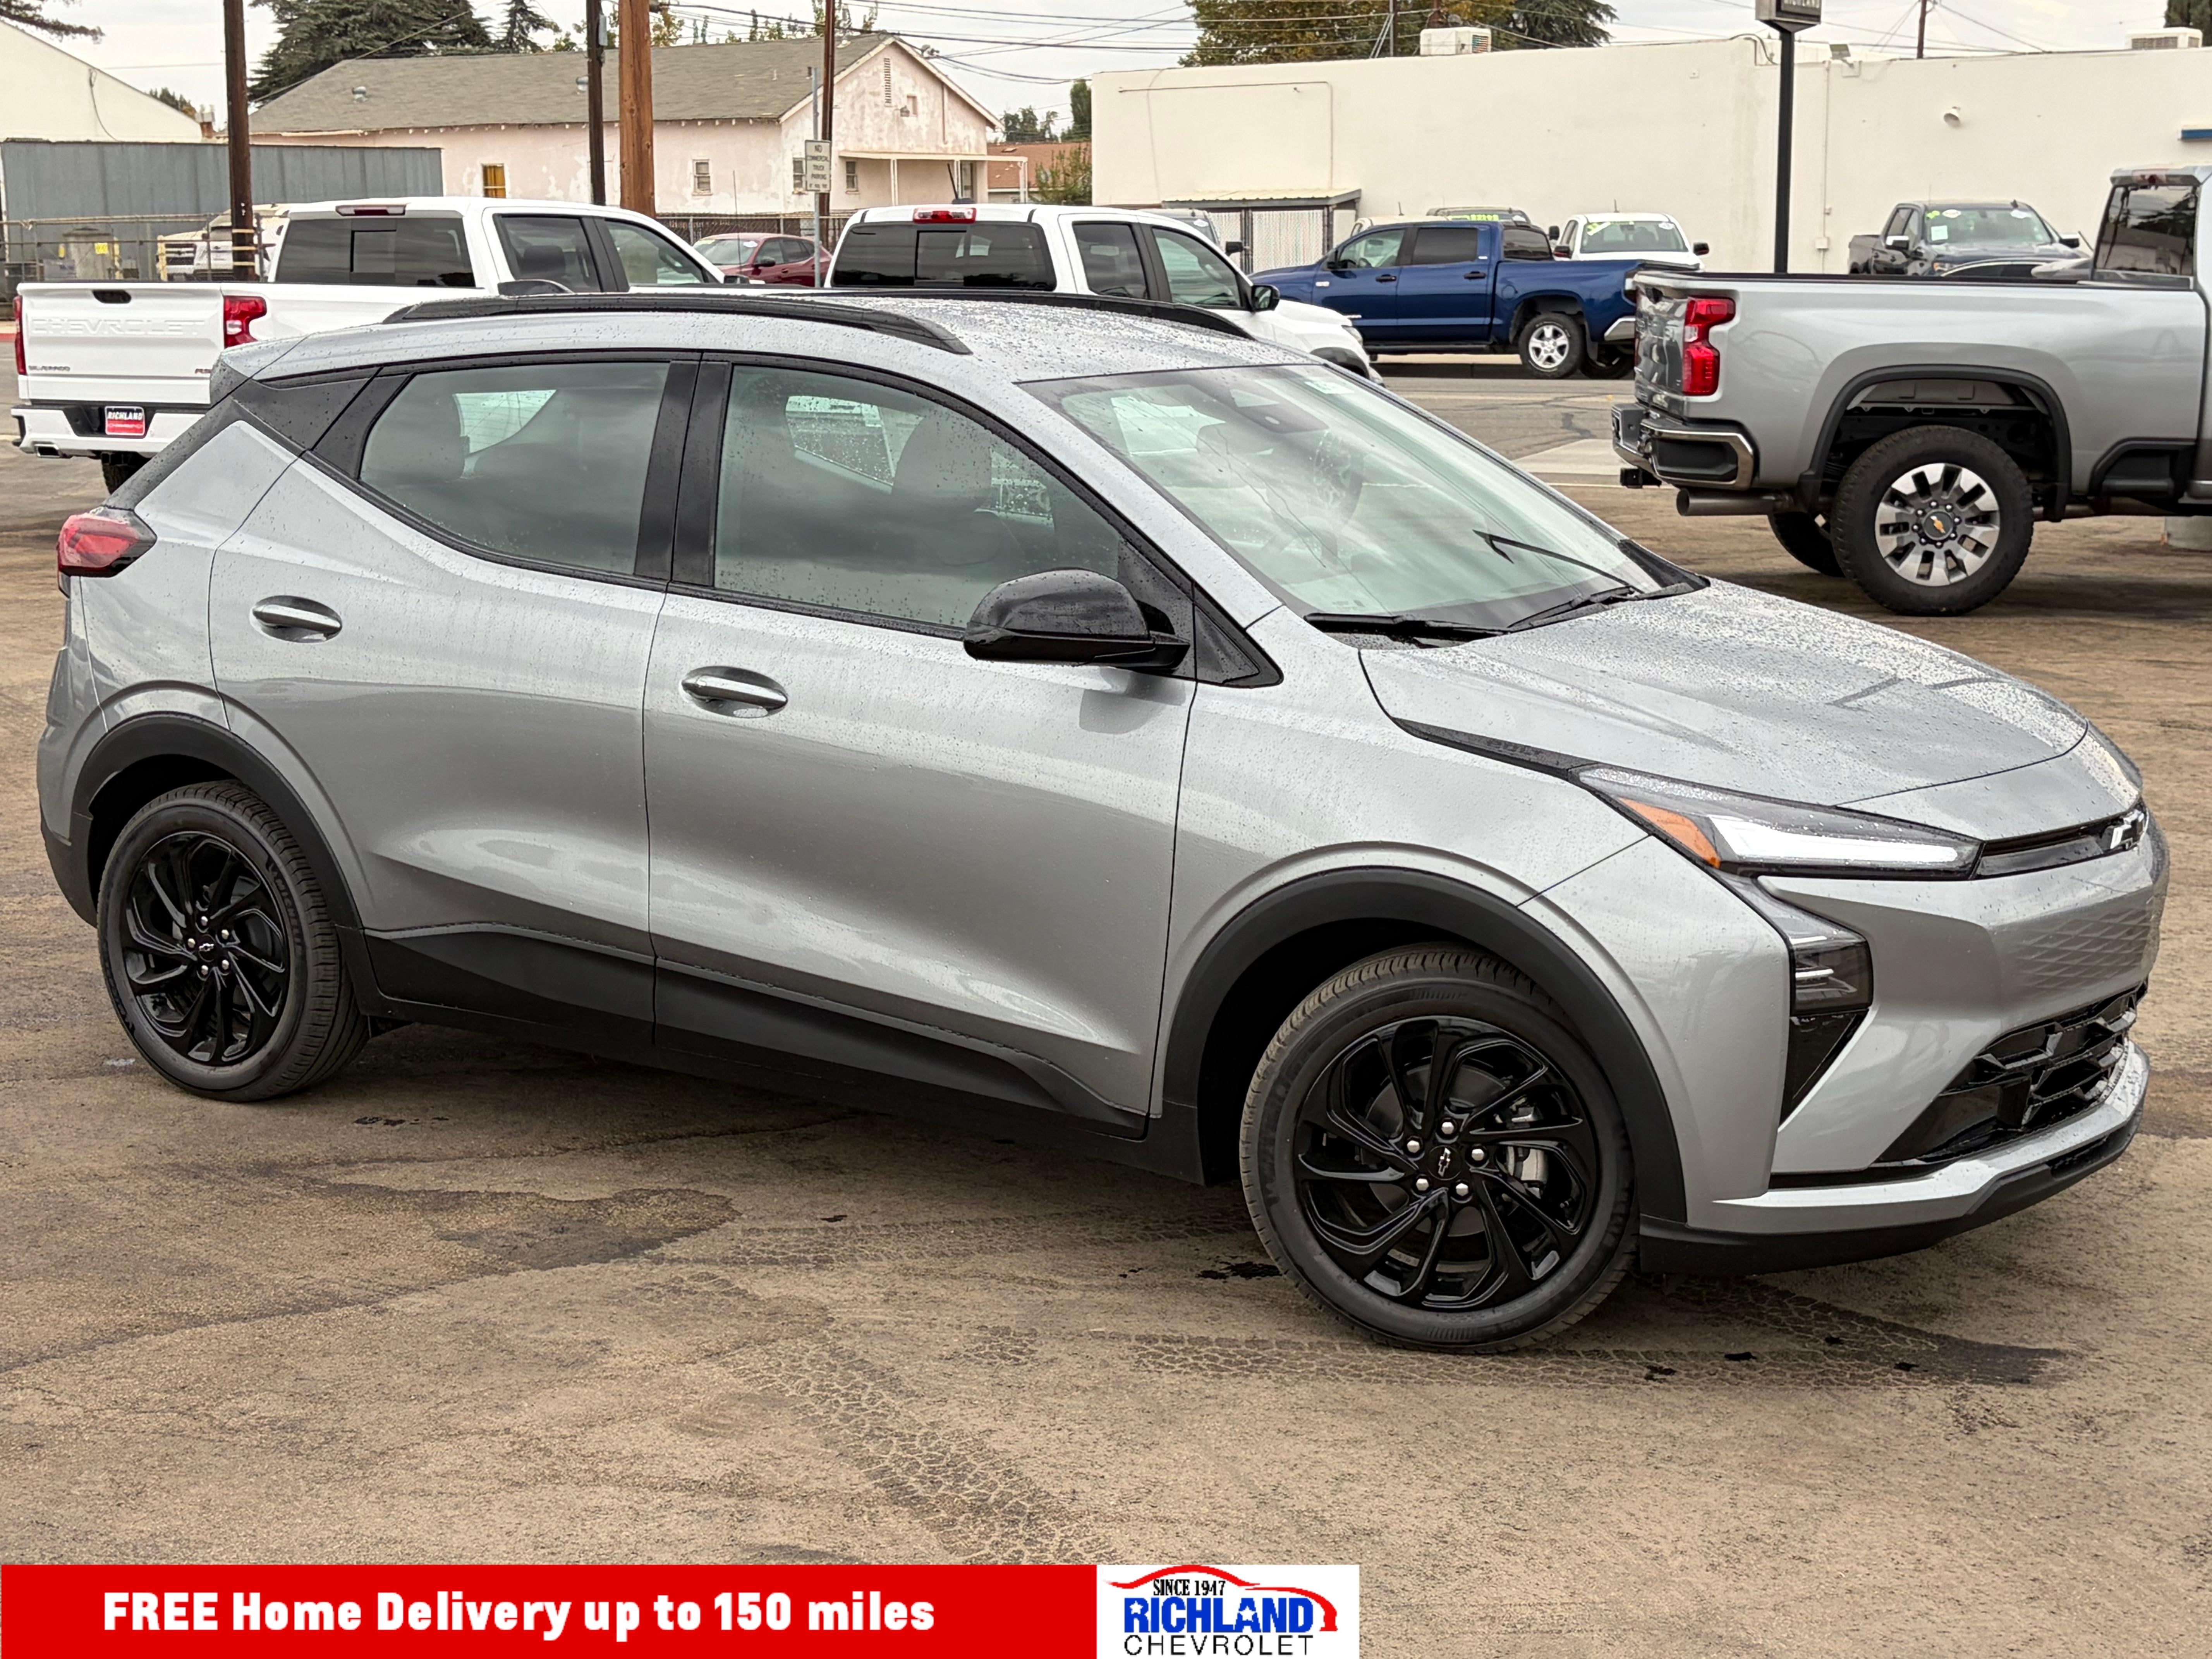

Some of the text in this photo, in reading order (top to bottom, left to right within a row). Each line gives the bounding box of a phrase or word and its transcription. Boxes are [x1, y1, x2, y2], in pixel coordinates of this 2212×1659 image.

[814, 144, 823, 153] NO
[31, 318, 205, 336] CHEVROLET
[108, 412, 143, 420] RICHLAND
[275, 878, 303, 957] MICHELIN
